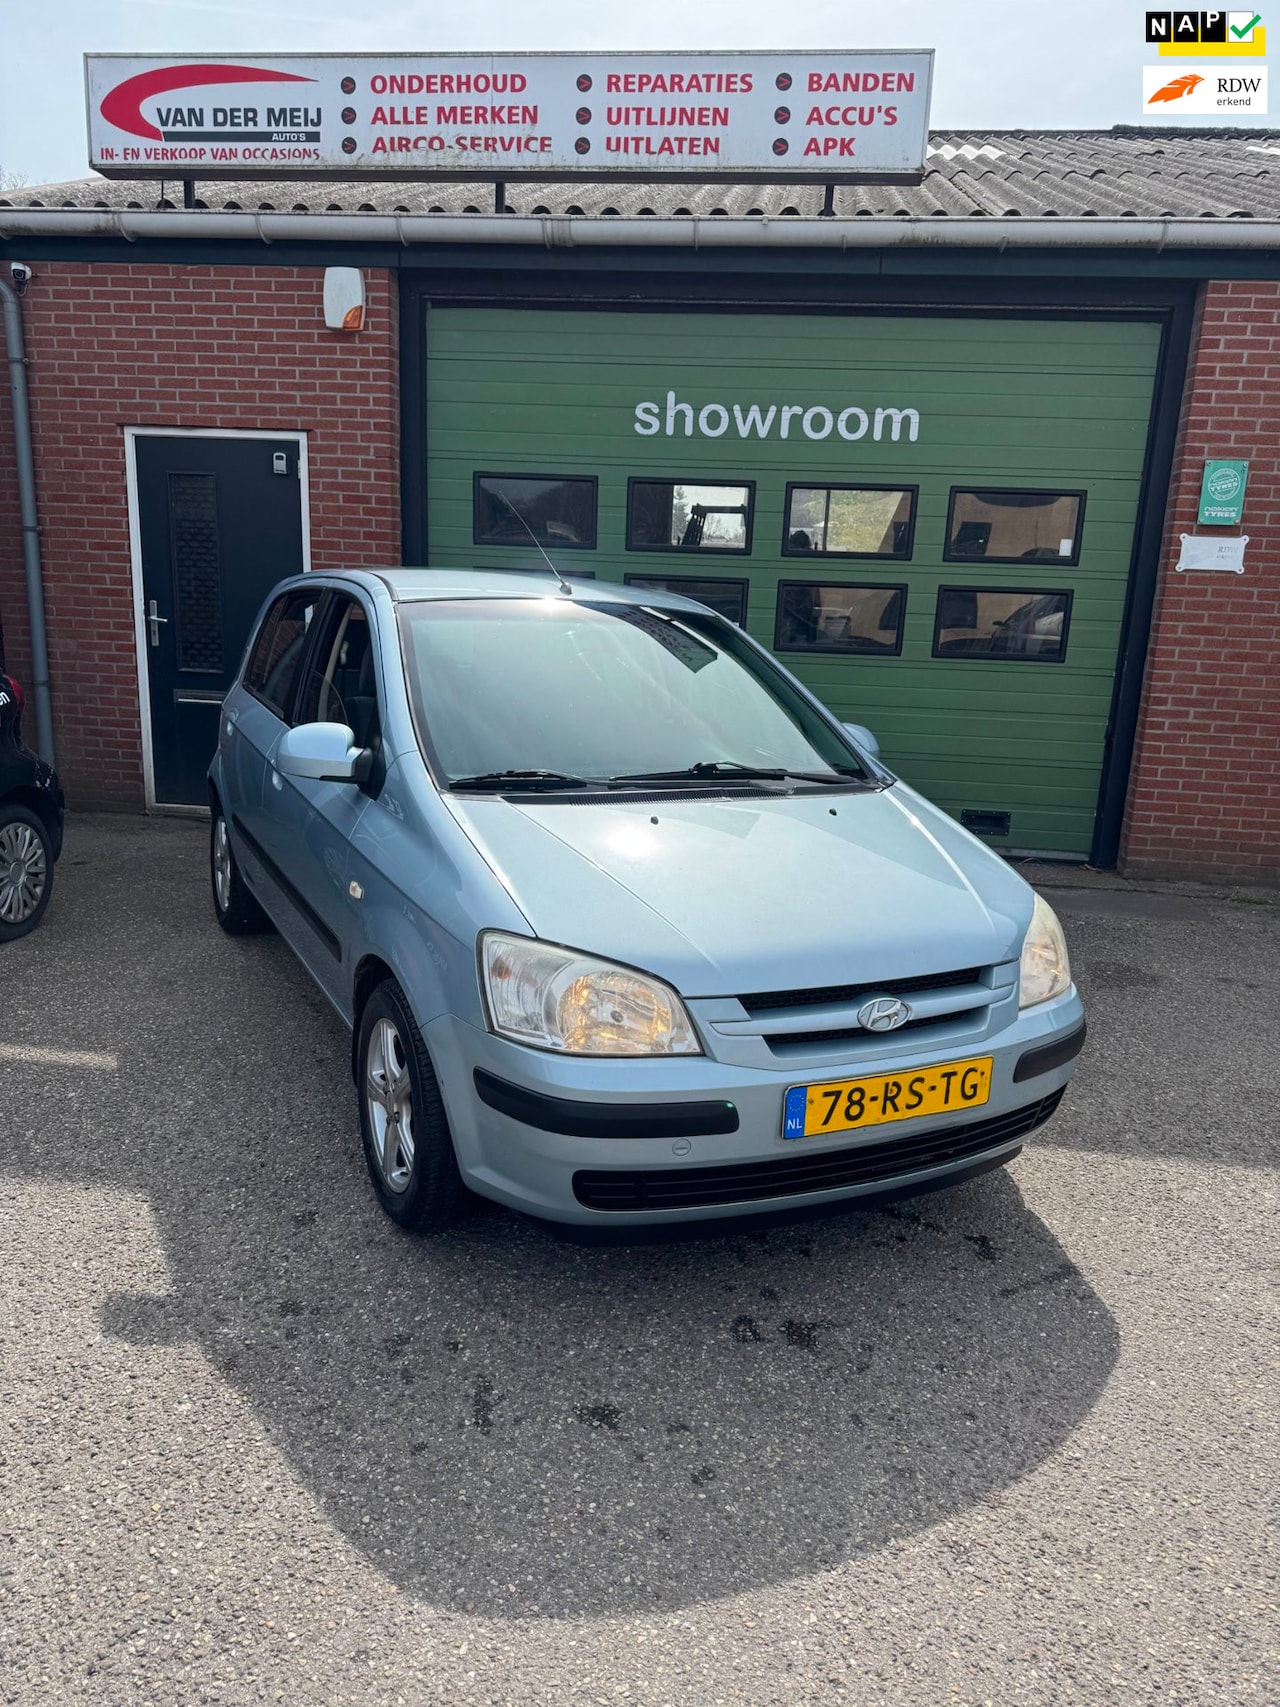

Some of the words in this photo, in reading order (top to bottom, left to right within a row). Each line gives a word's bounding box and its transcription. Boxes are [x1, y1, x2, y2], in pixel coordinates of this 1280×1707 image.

[370, 73, 527, 94] ONDERHOUD
[606, 73, 753, 93] REPARATIES
[807, 73, 915, 92] BANDEN
[156, 107, 204, 127] VAN
[213, 107, 258, 127] DER
[267, 107, 322, 127] MEIJ
[370, 106, 428, 125] ALLE
[436, 105, 538, 125] MERKEN
[606, 107, 729, 126] UITLIJNEN
[805, 105, 898, 126] ACCU'S
[271, 132, 306, 142] AUTO'S
[372, 136, 553, 154] AIRCO-SERVICE
[605, 136, 720, 155] UITLATEN
[803, 137, 856, 156] APK
[100, 147, 119, 161] IN-
[123, 147, 140, 161] EN
[144, 147, 207, 161] VERKOOP
[210, 147, 238, 161] VAN
[242, 147, 320, 161] OCCASIONS
[633, 390, 920, 442] showroom
[821, 1067, 979, 1127] 78-RS-TG
[787, 1119, 803, 1131] NL
